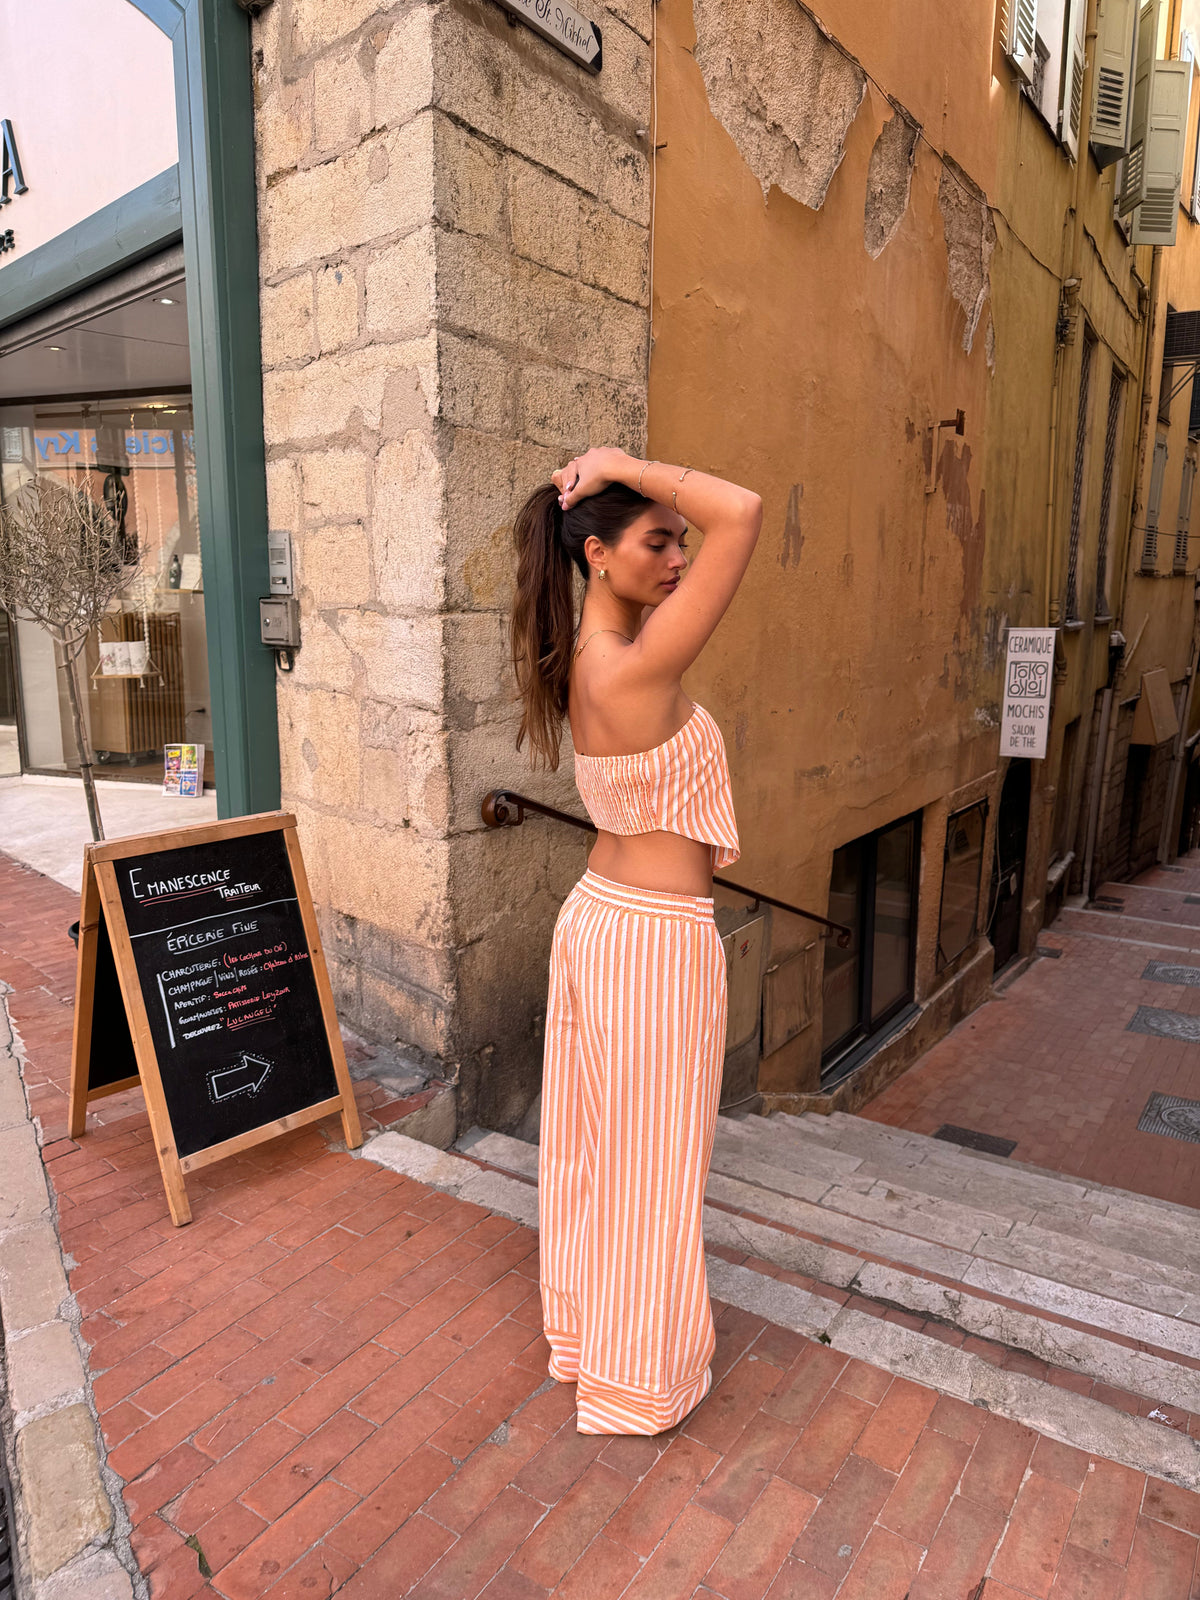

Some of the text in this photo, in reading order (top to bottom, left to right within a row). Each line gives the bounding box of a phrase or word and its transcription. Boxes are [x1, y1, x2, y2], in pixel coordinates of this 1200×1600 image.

[1008, 636, 1052, 655] CERAMIQUE
[1007, 704, 1045, 719] MOCHIS
[1011, 724, 1036, 736] SALON
[1010, 736, 1019, 747] DE
